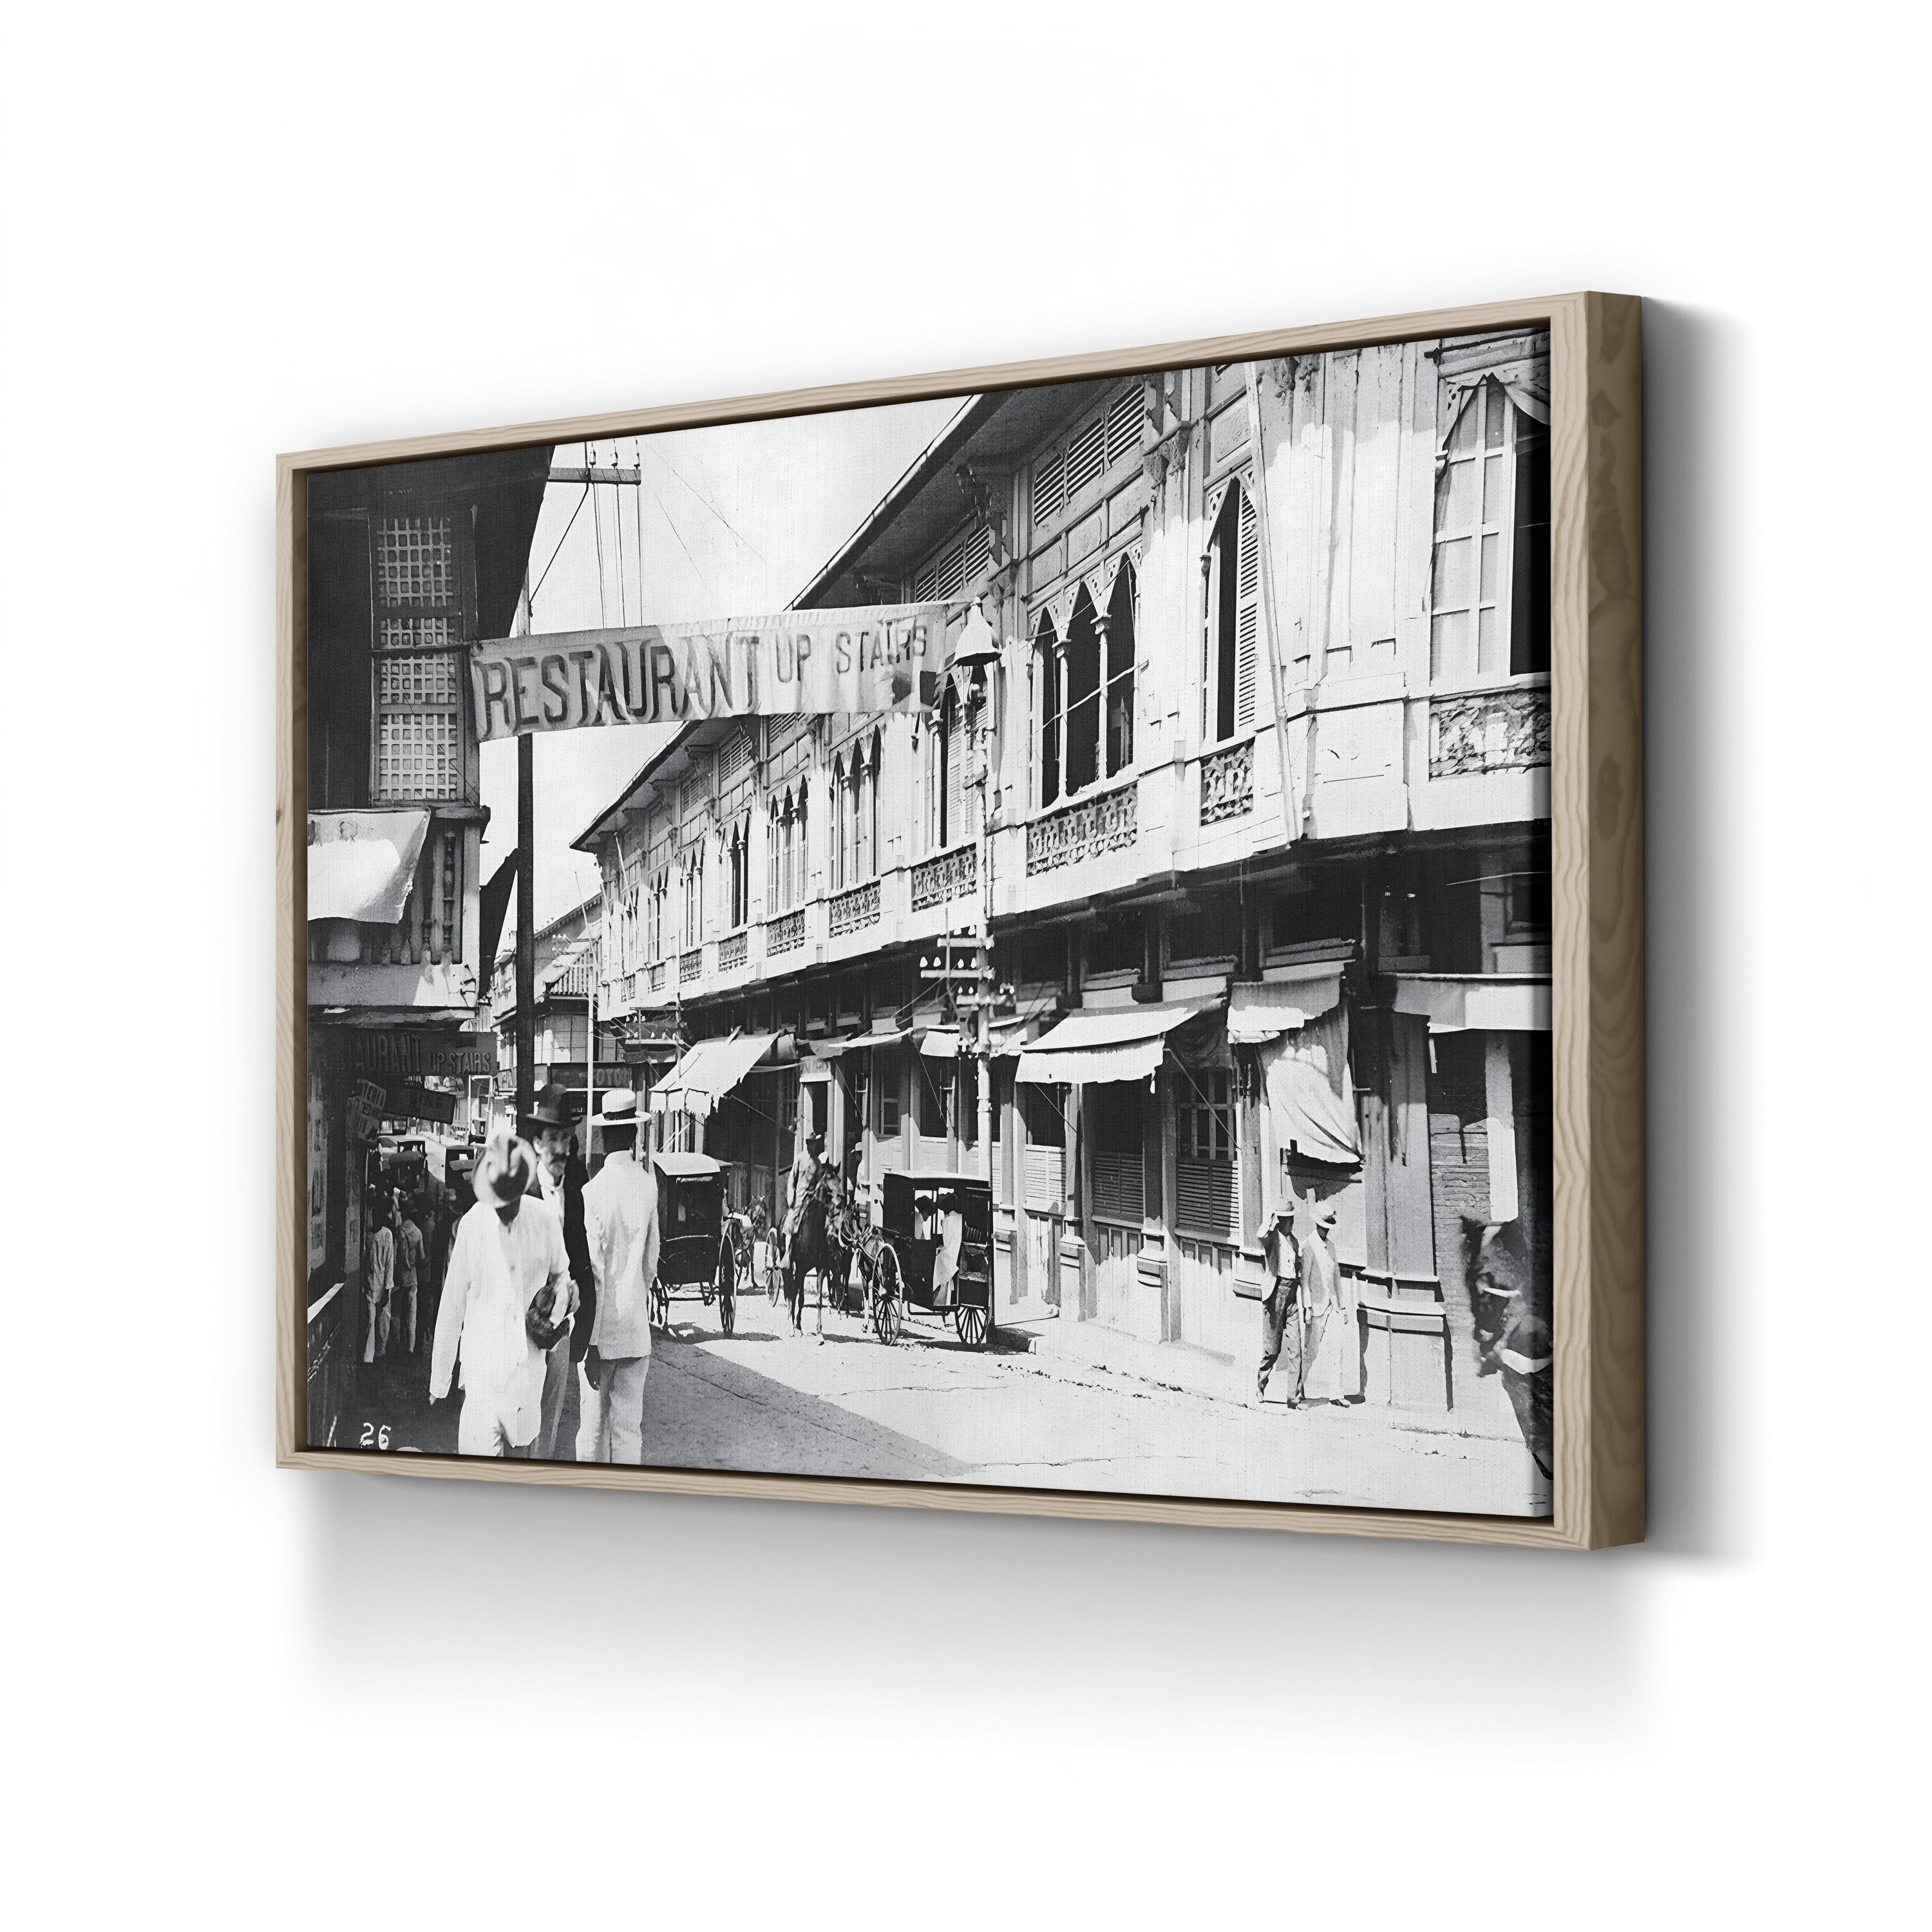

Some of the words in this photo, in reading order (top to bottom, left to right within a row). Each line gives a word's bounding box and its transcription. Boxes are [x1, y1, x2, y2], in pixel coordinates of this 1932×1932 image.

[472, 631, 759, 739] RESTAURANT
[775, 633, 811, 683] UP
[836, 622, 927, 674] STAIRS
[428, 1052, 445, 1072] UP
[448, 1052, 491, 1073] STAIRS
[359, 1422, 392, 1450] 26
